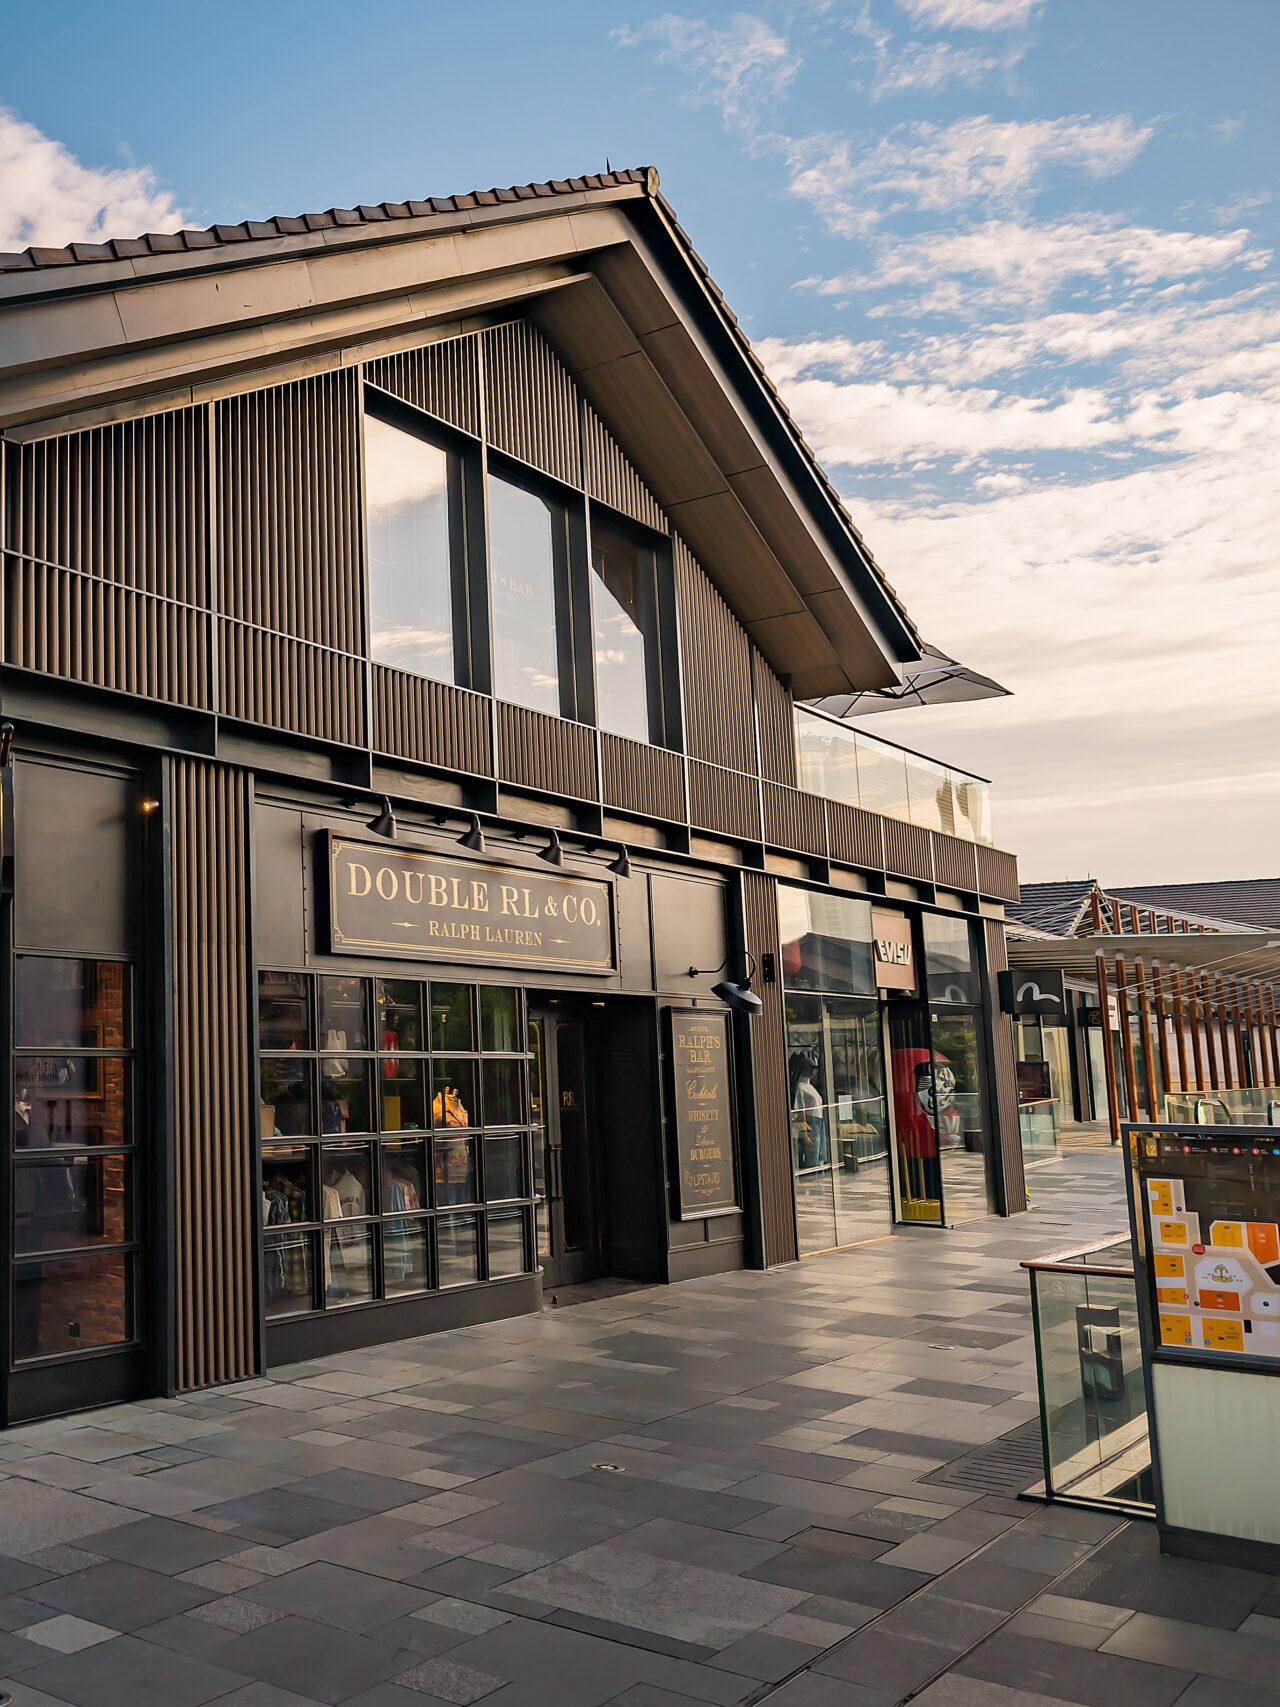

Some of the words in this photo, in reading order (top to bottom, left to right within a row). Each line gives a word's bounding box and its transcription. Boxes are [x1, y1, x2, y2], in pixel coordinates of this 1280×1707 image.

[346, 862, 489, 912] DOUBLE
[499, 885, 539, 918] RL
[429, 920, 481, 941] RALPH
[485, 927, 543, 947] LAUREN
[679, 1035, 720, 1049] RALPH'S
[690, 1050, 712, 1063] BAR
